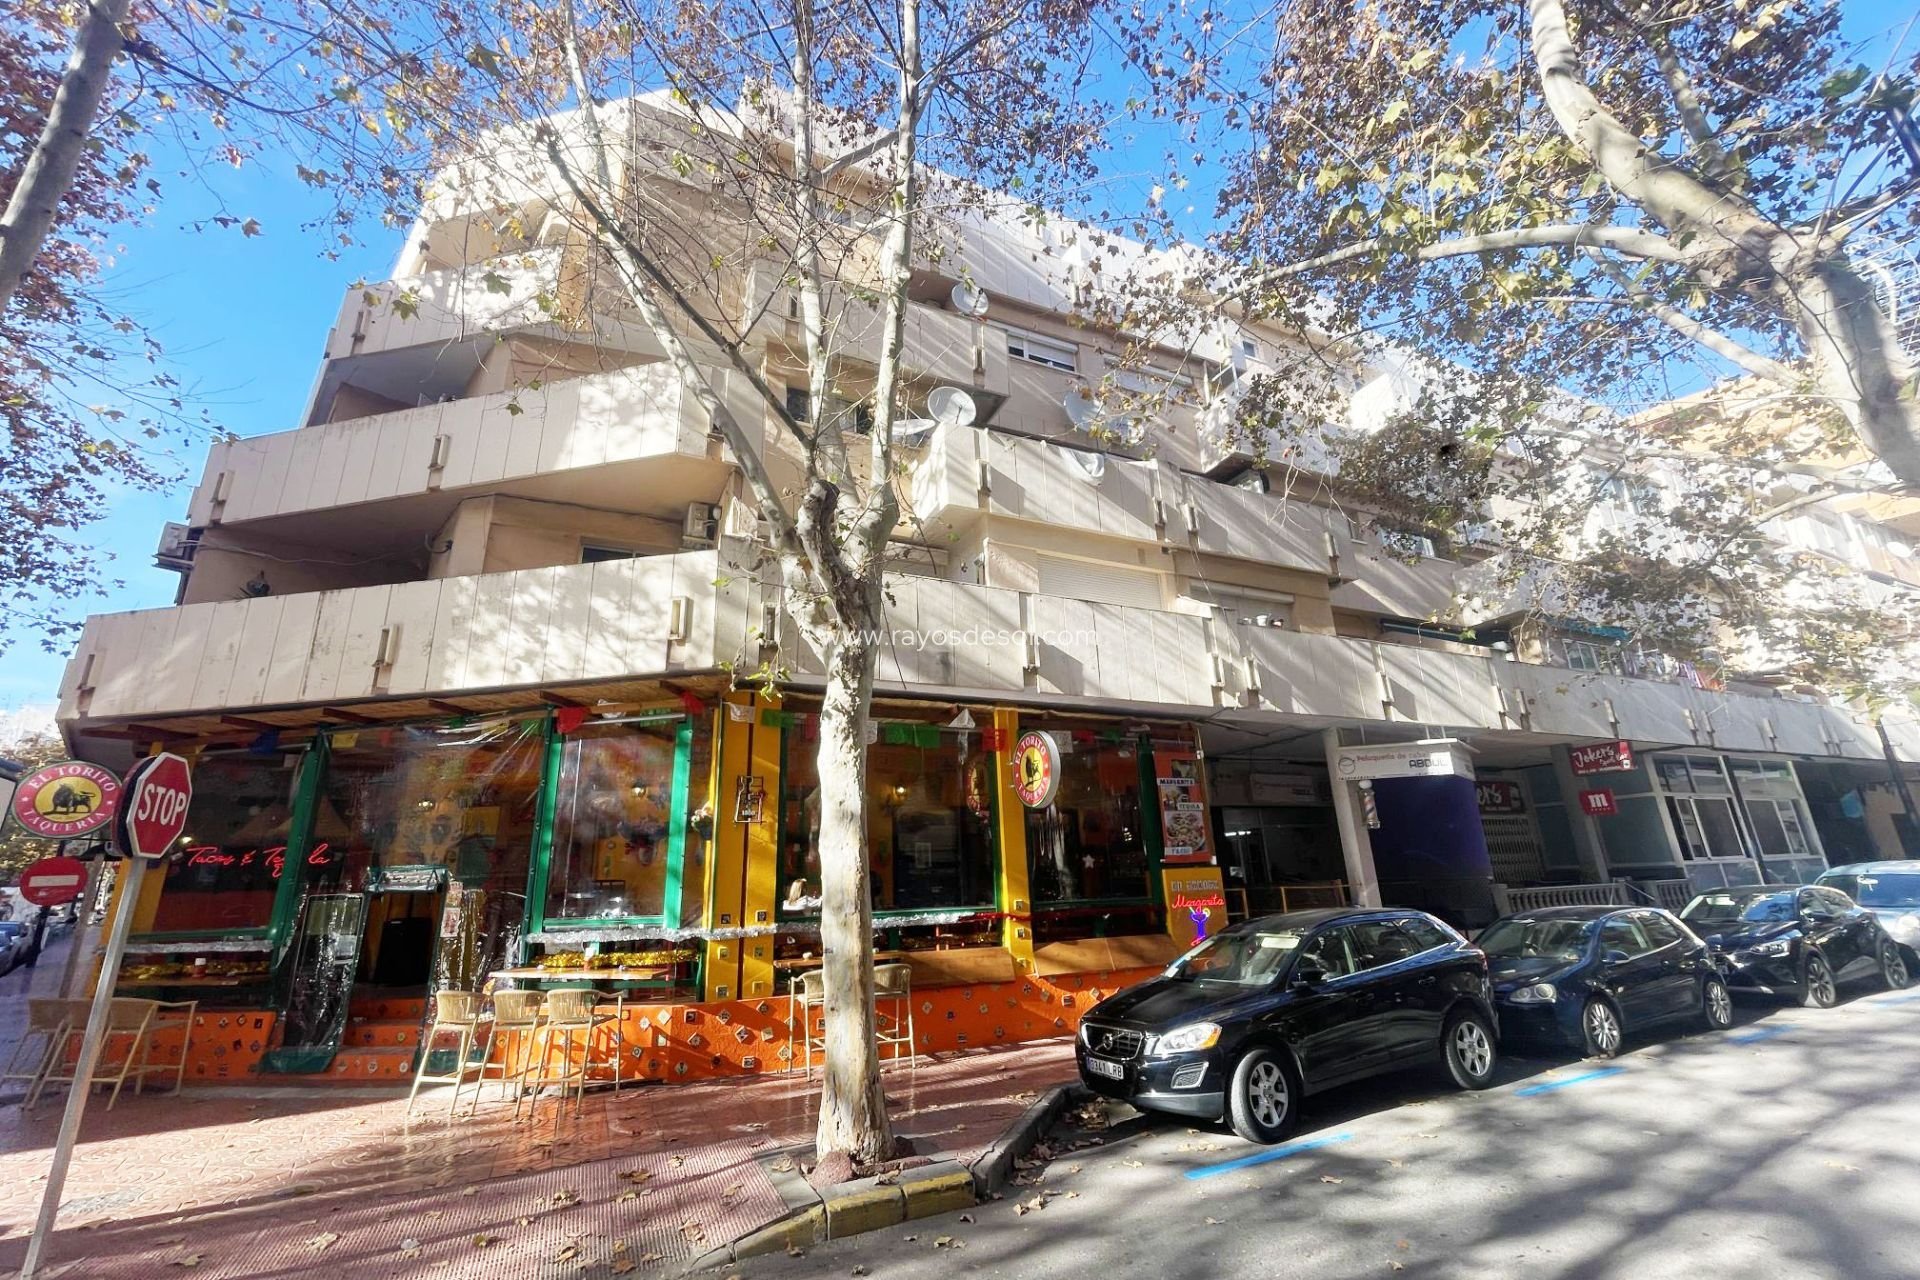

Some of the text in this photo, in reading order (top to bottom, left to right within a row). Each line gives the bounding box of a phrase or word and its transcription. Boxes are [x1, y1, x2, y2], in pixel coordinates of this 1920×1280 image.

[1015, 735, 1047, 765] EL TORITO
[1572, 745, 1615, 768] Jokers
[28, 765, 116, 791] EL TORITO
[138, 783, 187, 826] STOP
[24, 810, 105, 832] TAQUERIA
[1172, 893, 1224, 913] Margarita
